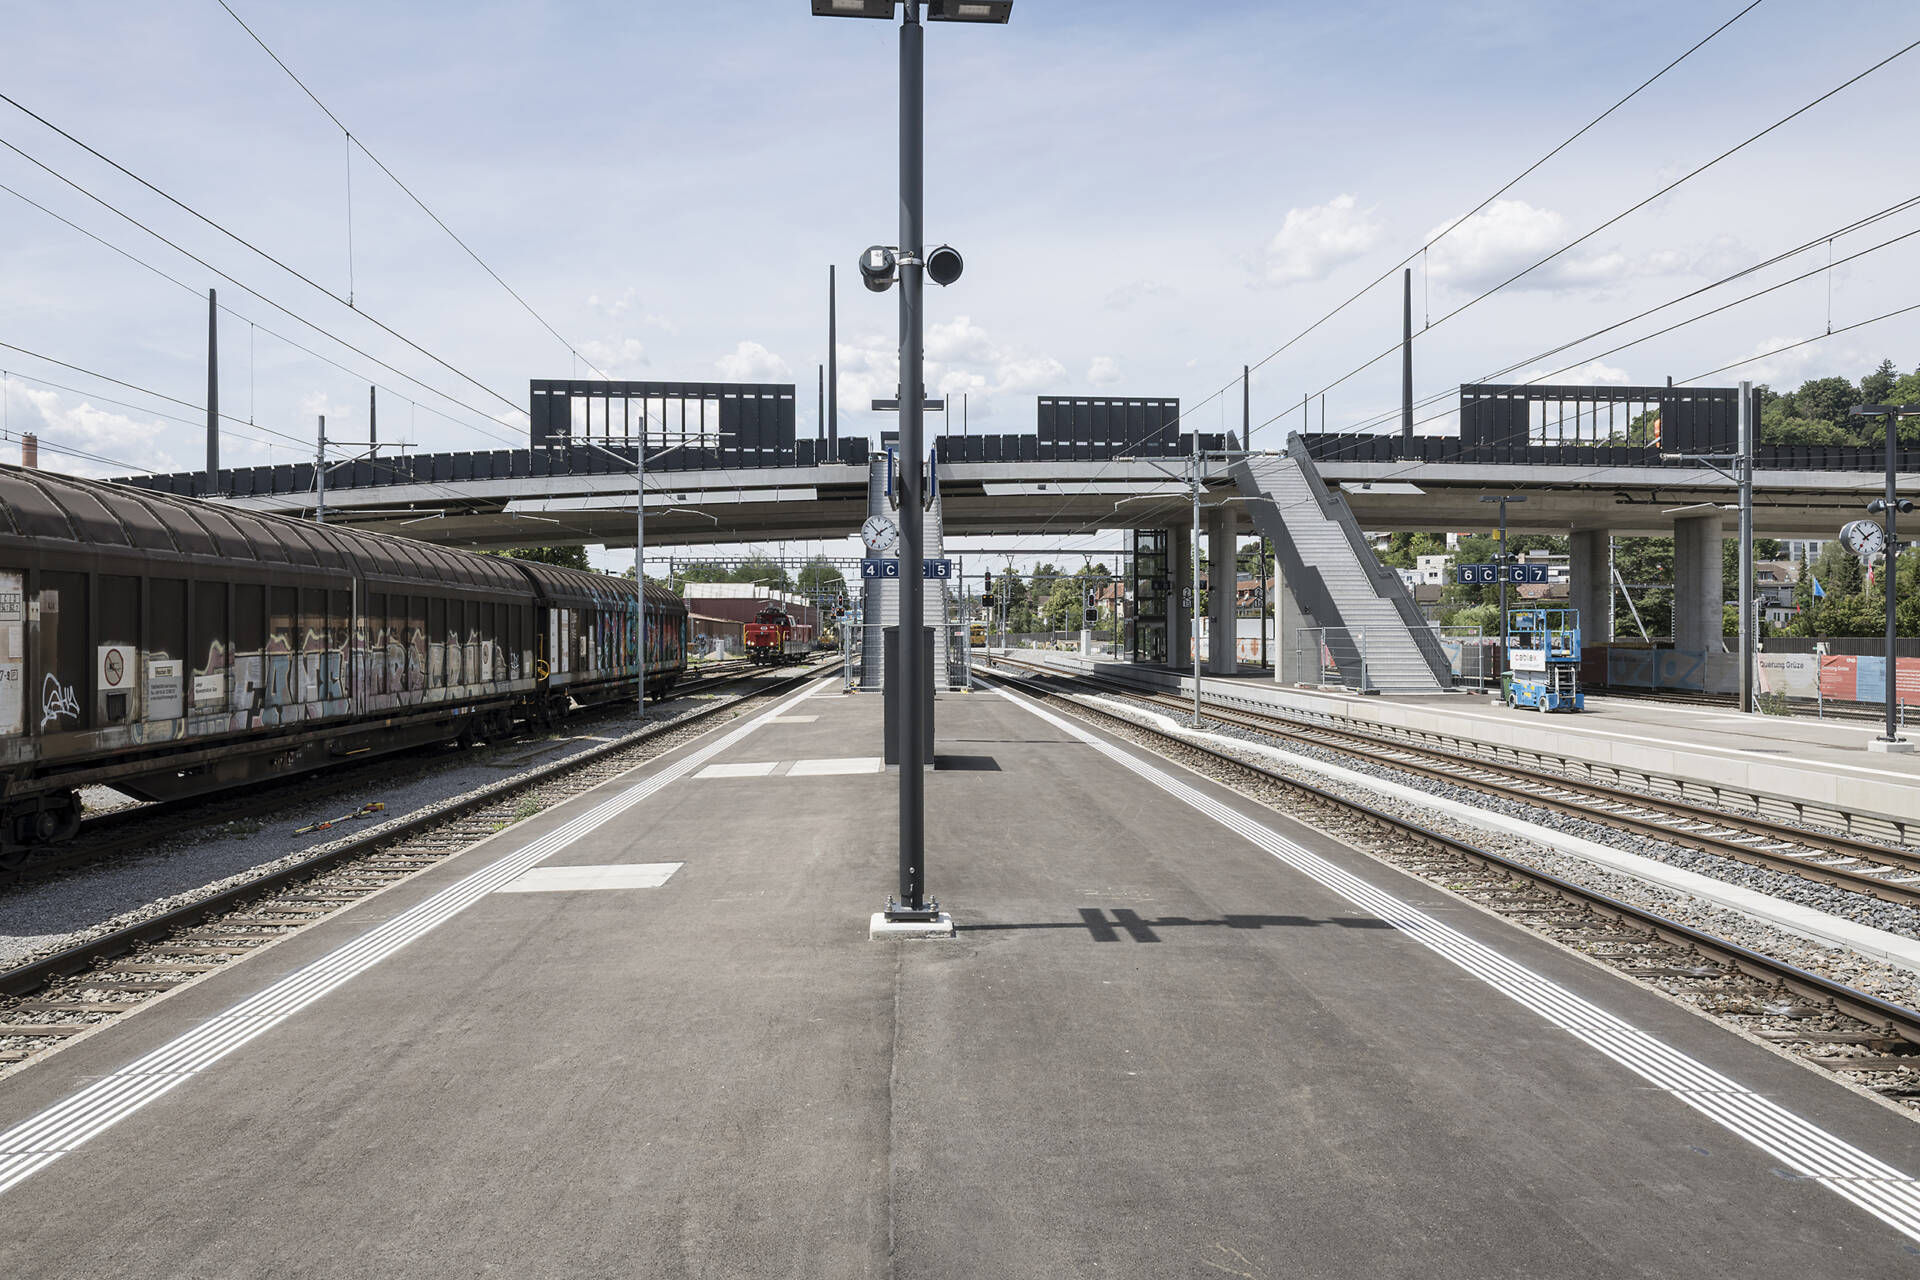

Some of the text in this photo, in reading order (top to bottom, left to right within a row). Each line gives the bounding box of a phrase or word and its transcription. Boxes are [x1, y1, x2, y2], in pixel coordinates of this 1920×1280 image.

[866, 565, 875, 575] 4
[886, 565, 895, 575] C
[937, 565, 945, 575] 5
[1464, 570, 1543, 580] 6 C C 7
[1760, 660, 1804, 669] Querung Grüze
